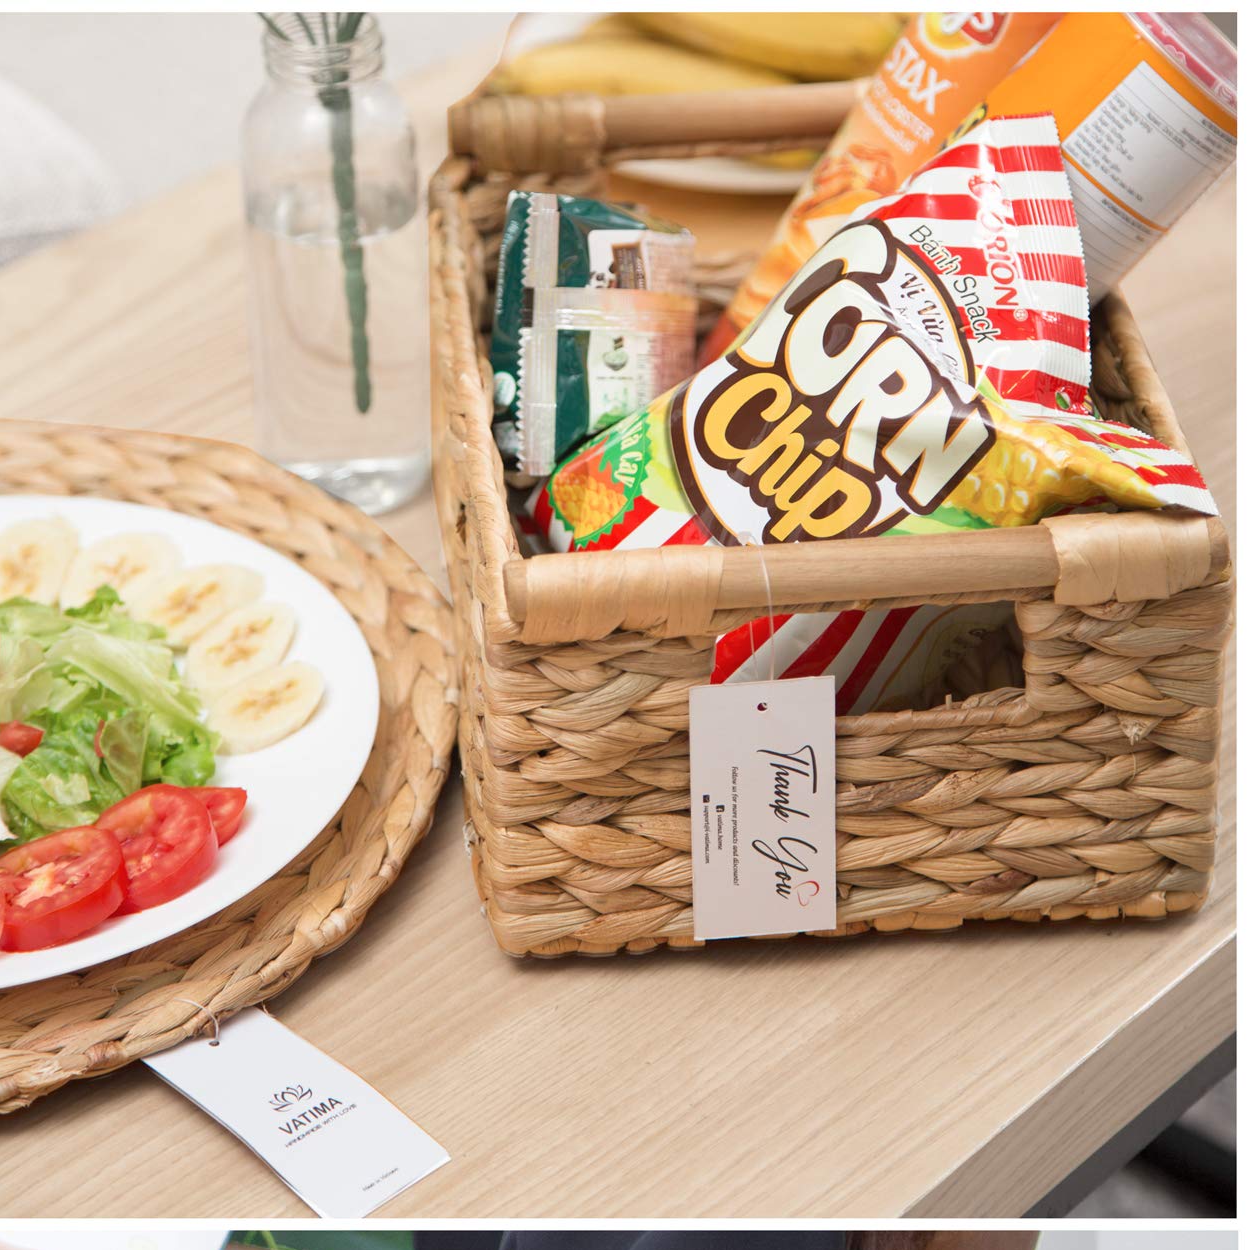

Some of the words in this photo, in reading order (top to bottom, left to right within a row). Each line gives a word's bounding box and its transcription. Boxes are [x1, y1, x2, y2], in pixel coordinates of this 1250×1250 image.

[886, 37, 951, 115] STAX
[909, 225, 959, 275] Bánh
[953, 276, 999, 343] Snack
[736, 224, 989, 507] CORN
[704, 372, 872, 541] Chip
[756, 745, 817, 823] Thank
[752, 836, 818, 900] You
[278, 1097, 342, 1135] VATIMA
